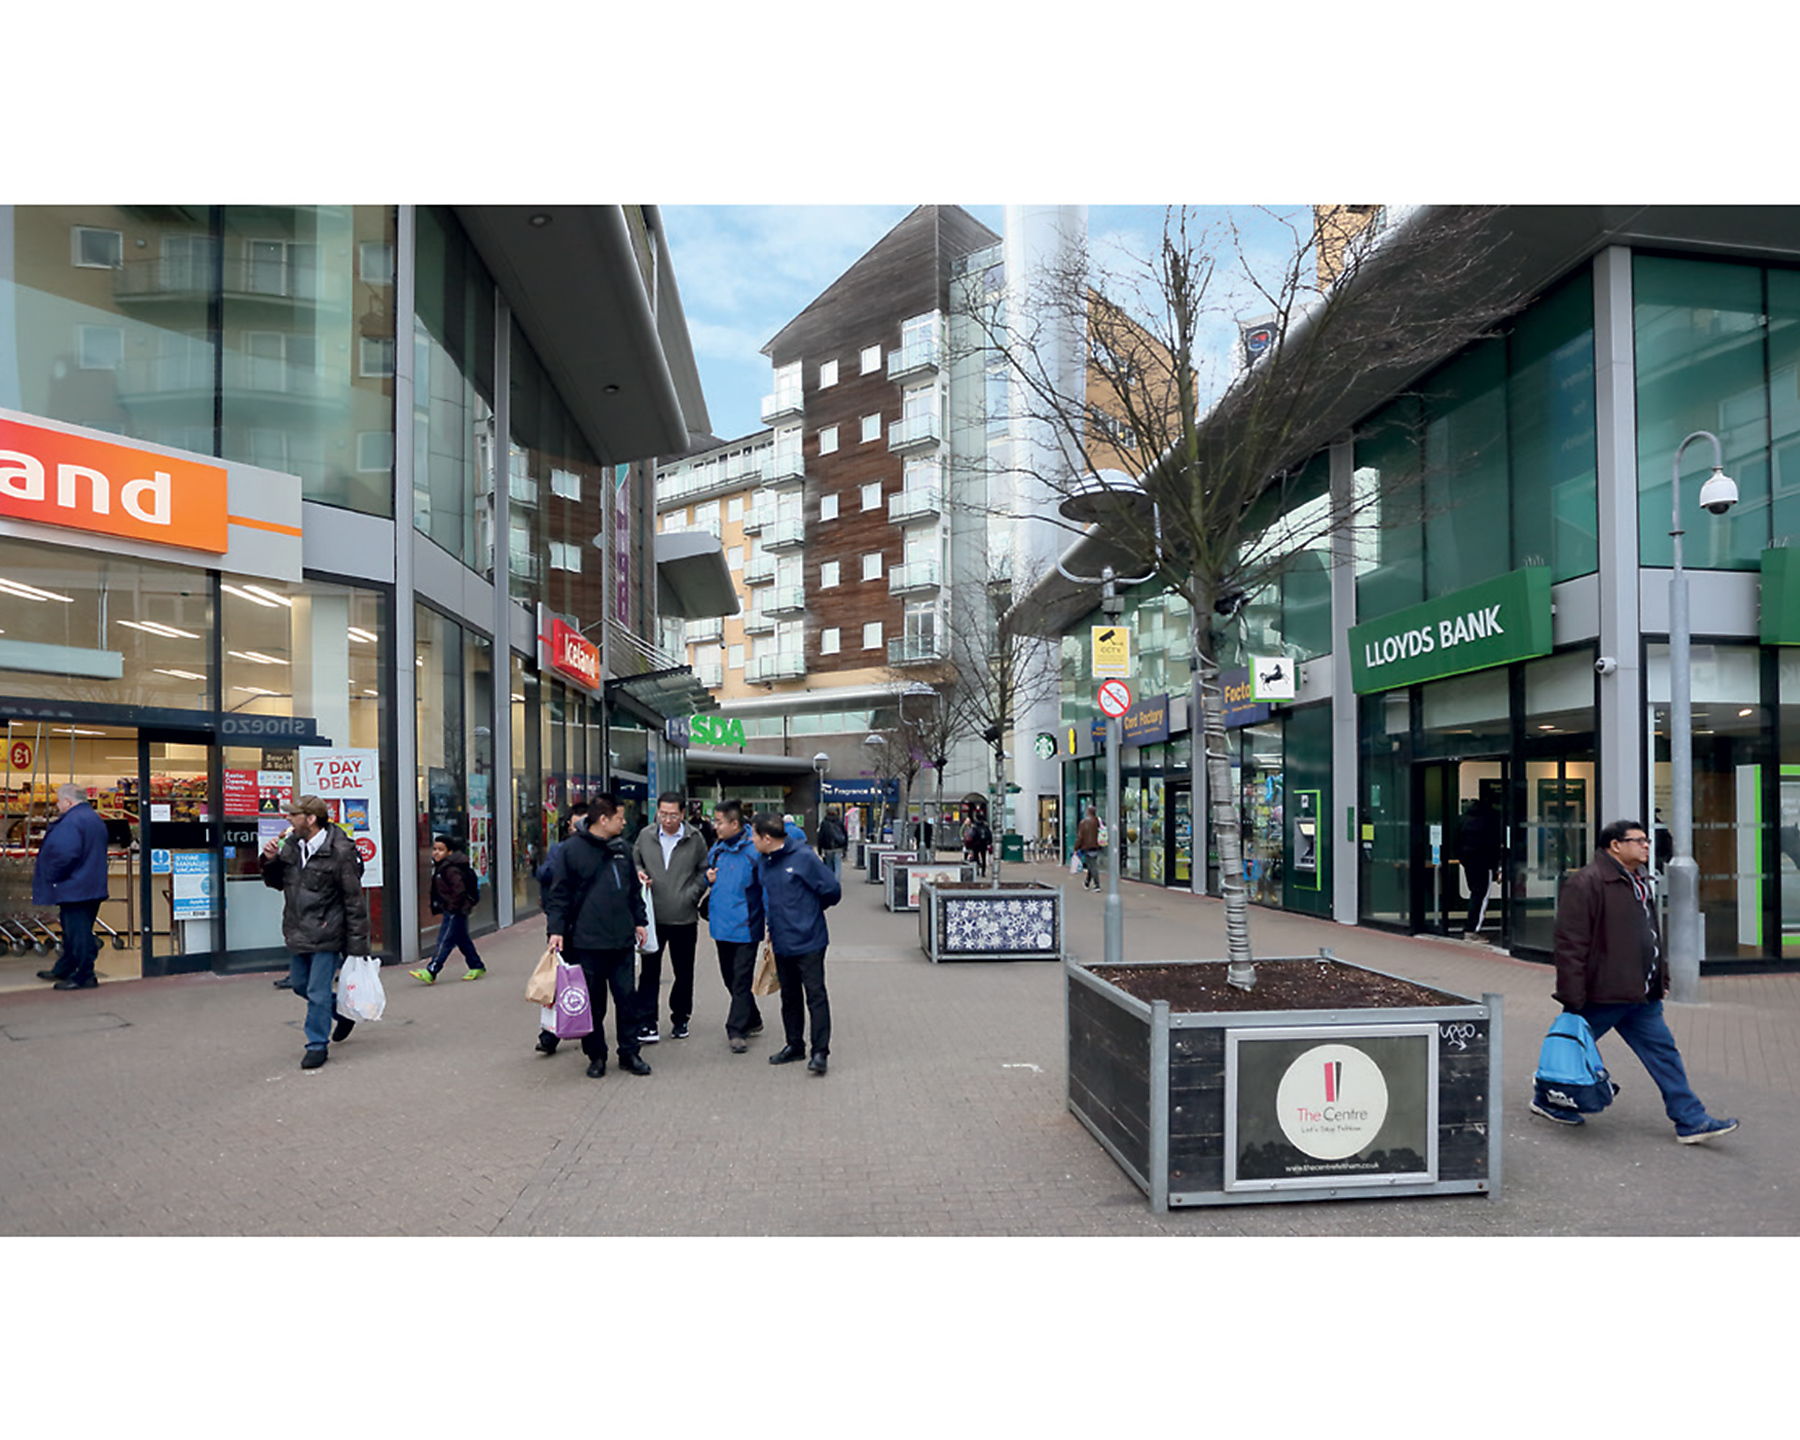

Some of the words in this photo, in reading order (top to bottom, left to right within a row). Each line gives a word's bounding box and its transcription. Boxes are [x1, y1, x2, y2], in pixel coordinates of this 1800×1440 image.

[0, 449, 171, 525] and
[1365, 625, 1435, 668] LLOYDS
[1439, 604, 1504, 649] BANK
[564, 632, 597, 680] Iceland
[1139, 708, 1164, 727] Factory
[14, 748, 29, 764] £1
[313, 761, 324, 776] 7
[329, 760, 362, 774] DAY
[319, 776, 363, 790] DEAL
[1296, 1107, 1321, 1121] The
[1323, 1106, 1368, 1121] Centre
